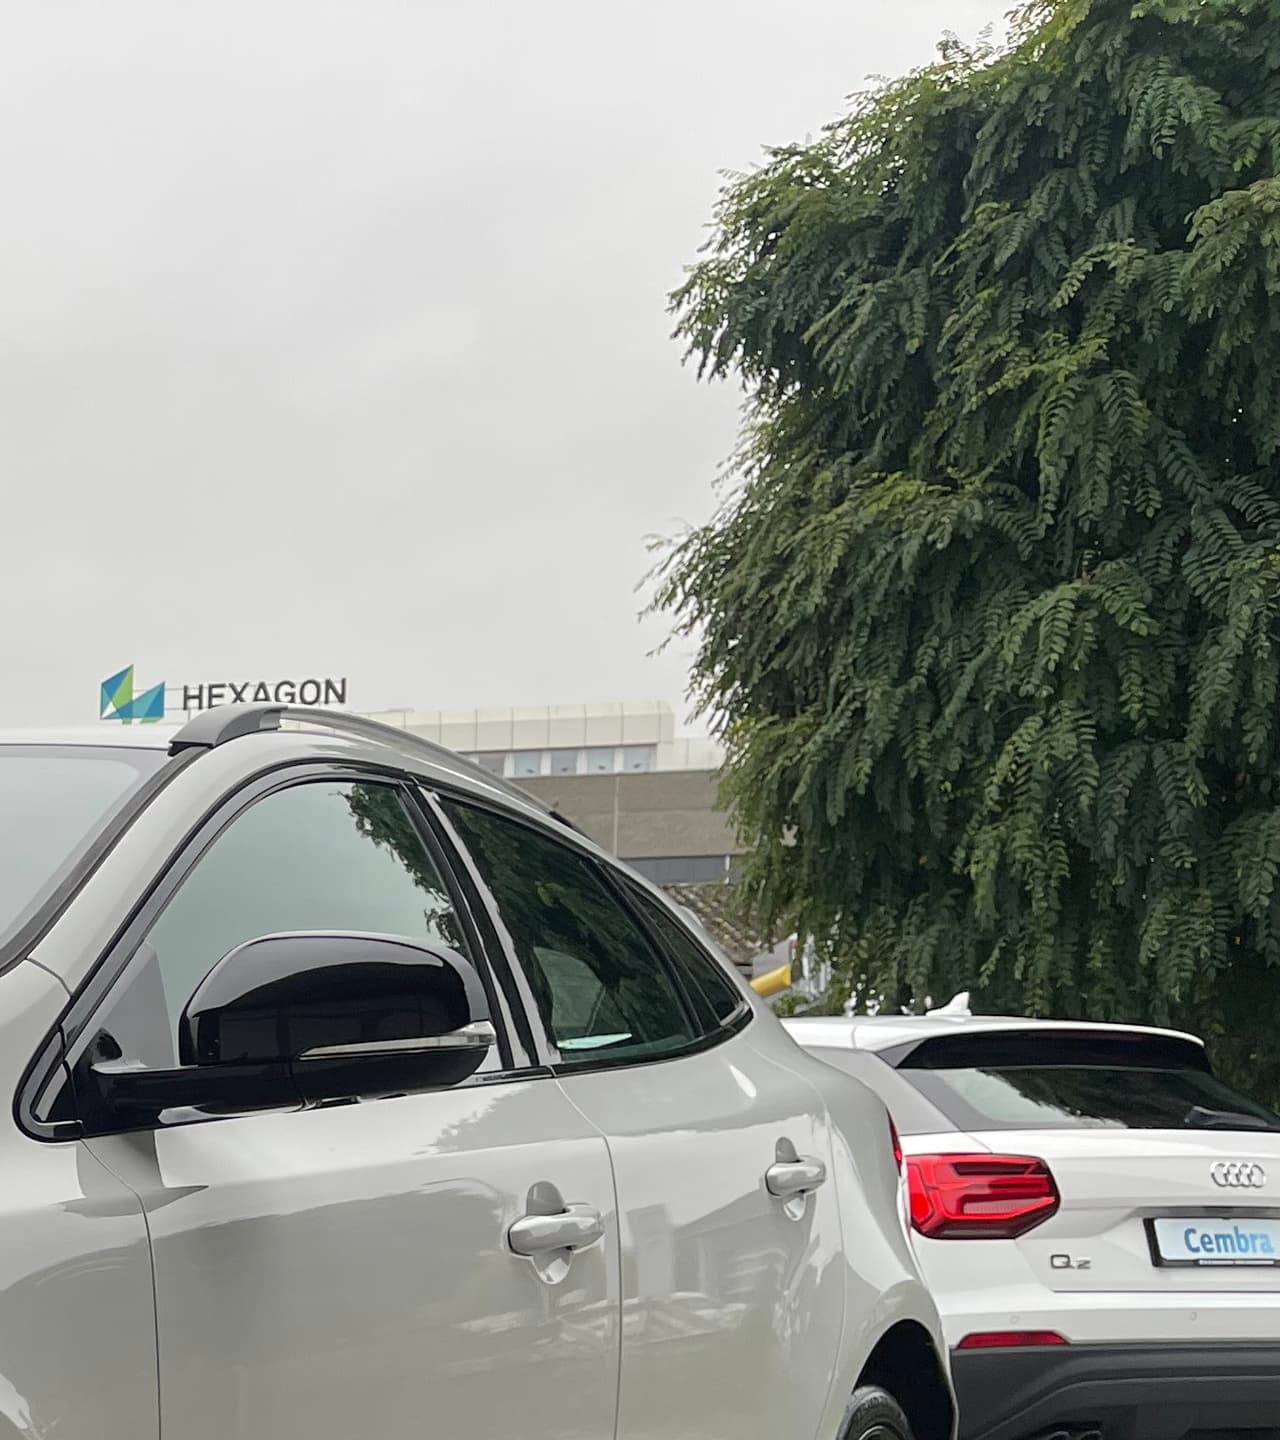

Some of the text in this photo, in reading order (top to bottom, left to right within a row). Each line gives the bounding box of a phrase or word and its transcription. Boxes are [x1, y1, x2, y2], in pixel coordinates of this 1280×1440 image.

[183, 678, 347, 710] HEXAGON
[1183, 1226, 1275, 1254] Cembra
[1050, 1254, 1092, 1270] Q2
